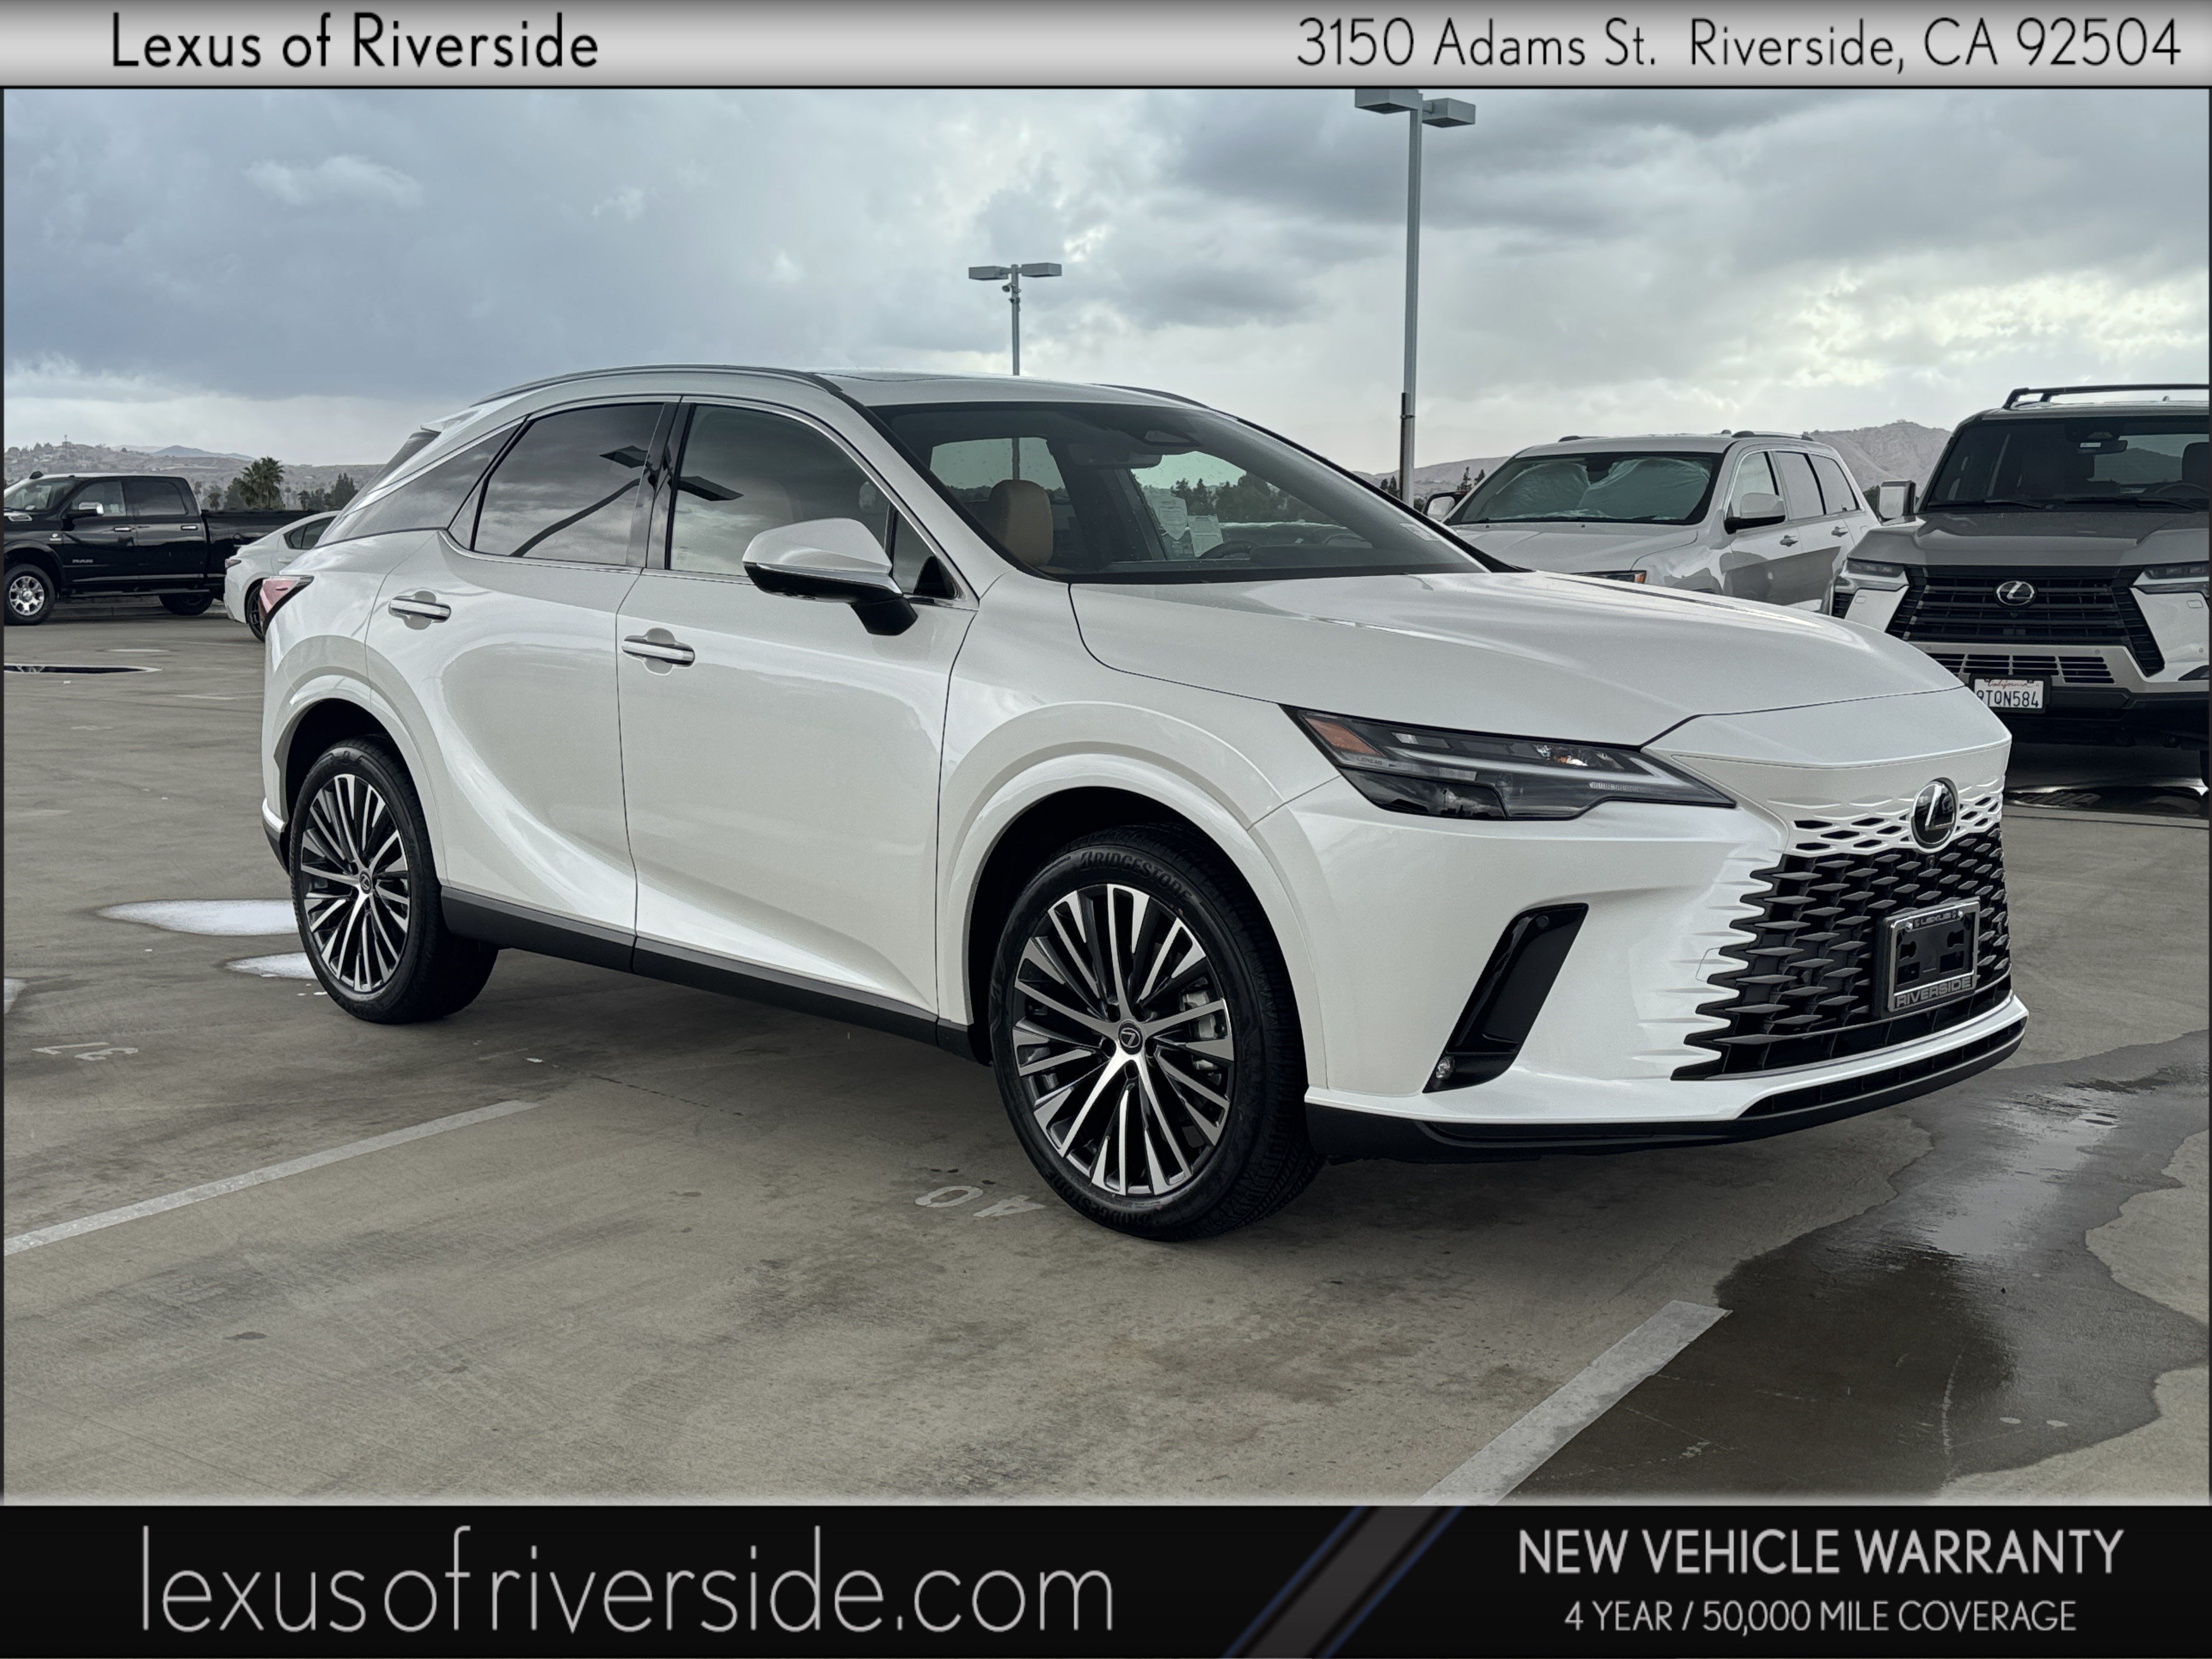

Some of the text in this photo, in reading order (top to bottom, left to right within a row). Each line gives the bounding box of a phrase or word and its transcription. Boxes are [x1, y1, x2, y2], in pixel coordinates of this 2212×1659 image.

[1080, 850, 1192, 902] BRIDGESTONE
[1921, 912, 1951, 925] LEXUS
[1896, 978, 1972, 1008] RIVERSIDE
[915, 1185, 1046, 1218] 40
